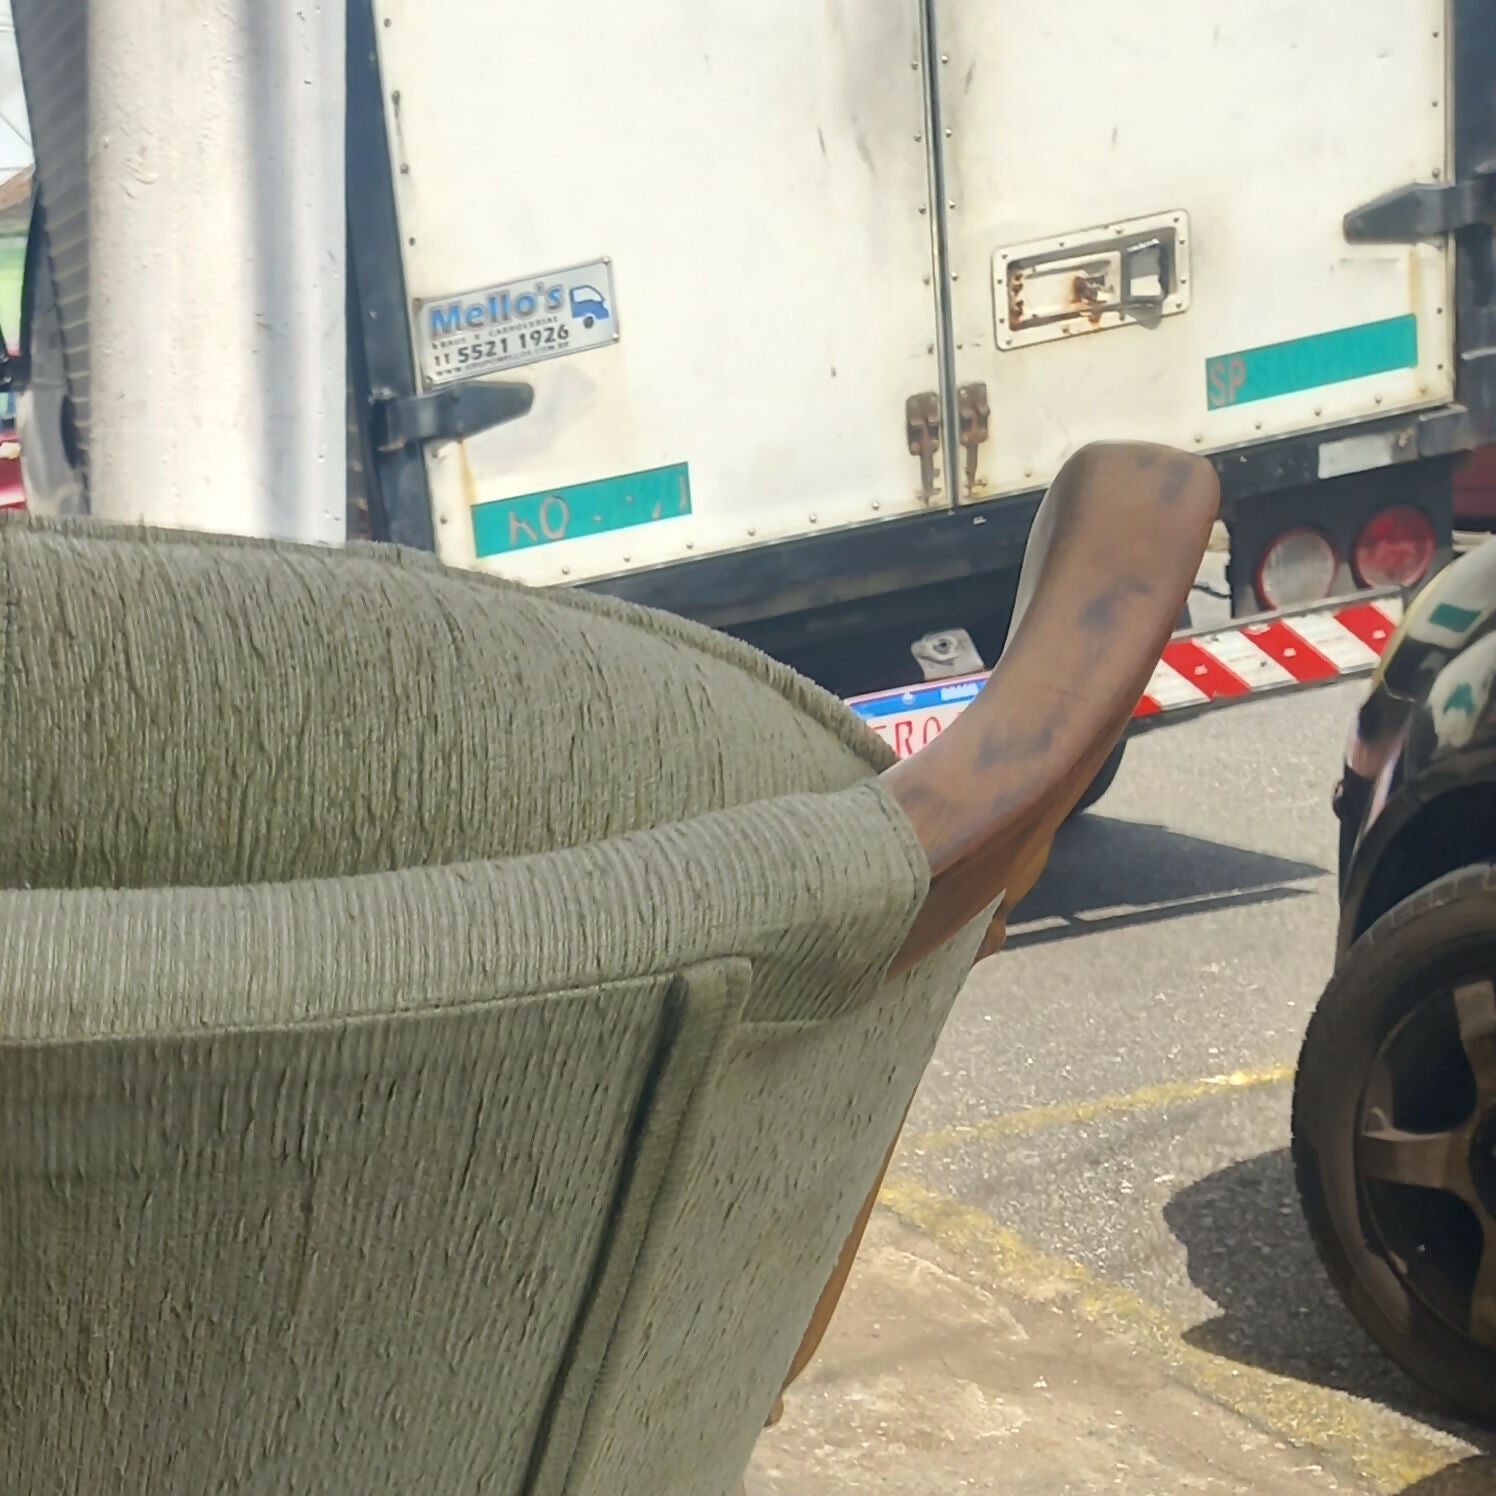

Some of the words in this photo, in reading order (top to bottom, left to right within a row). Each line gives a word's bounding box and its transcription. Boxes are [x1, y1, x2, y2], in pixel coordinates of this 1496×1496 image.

[429, 282, 564, 339] Mello's
[457, 338, 508, 364] 5521
[519, 324, 570, 350] 1926
[1209, 358, 1246, 407] SP
